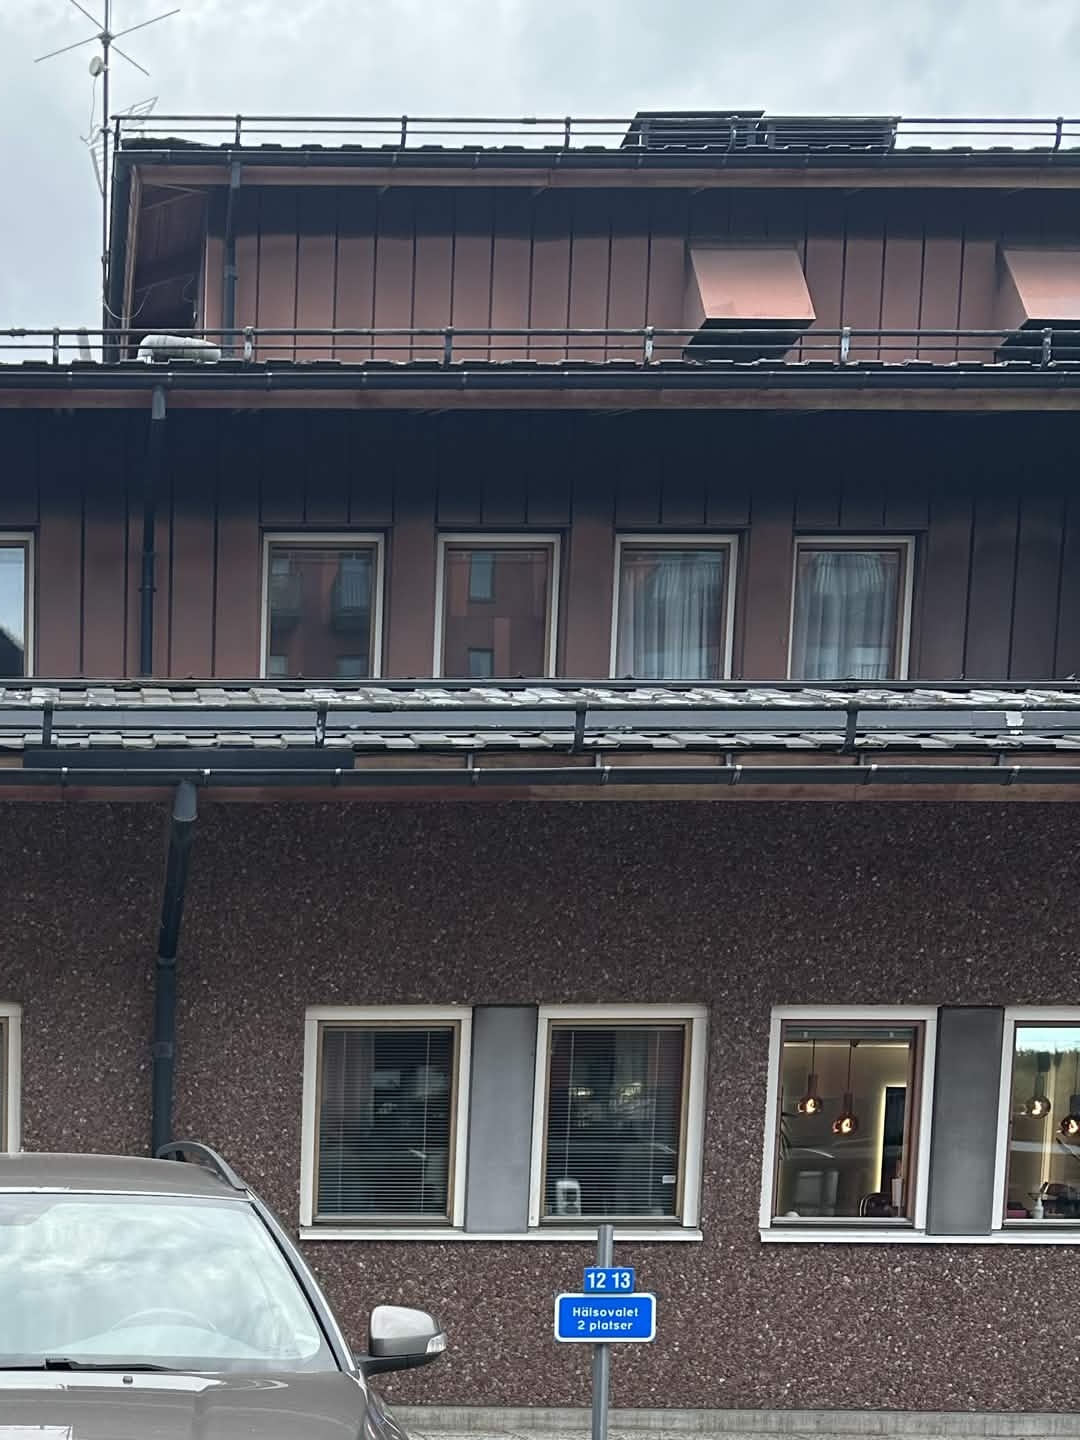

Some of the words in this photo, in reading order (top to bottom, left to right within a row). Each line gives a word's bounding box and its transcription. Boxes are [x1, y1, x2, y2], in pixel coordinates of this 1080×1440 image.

[587, 1272, 606, 1289] 12
[611, 1272, 631, 1289] 13
[572, 1307, 639, 1317] Hälsovalet
[578, 1320, 585, 1330] 2
[589, 1320, 632, 1332] platser
